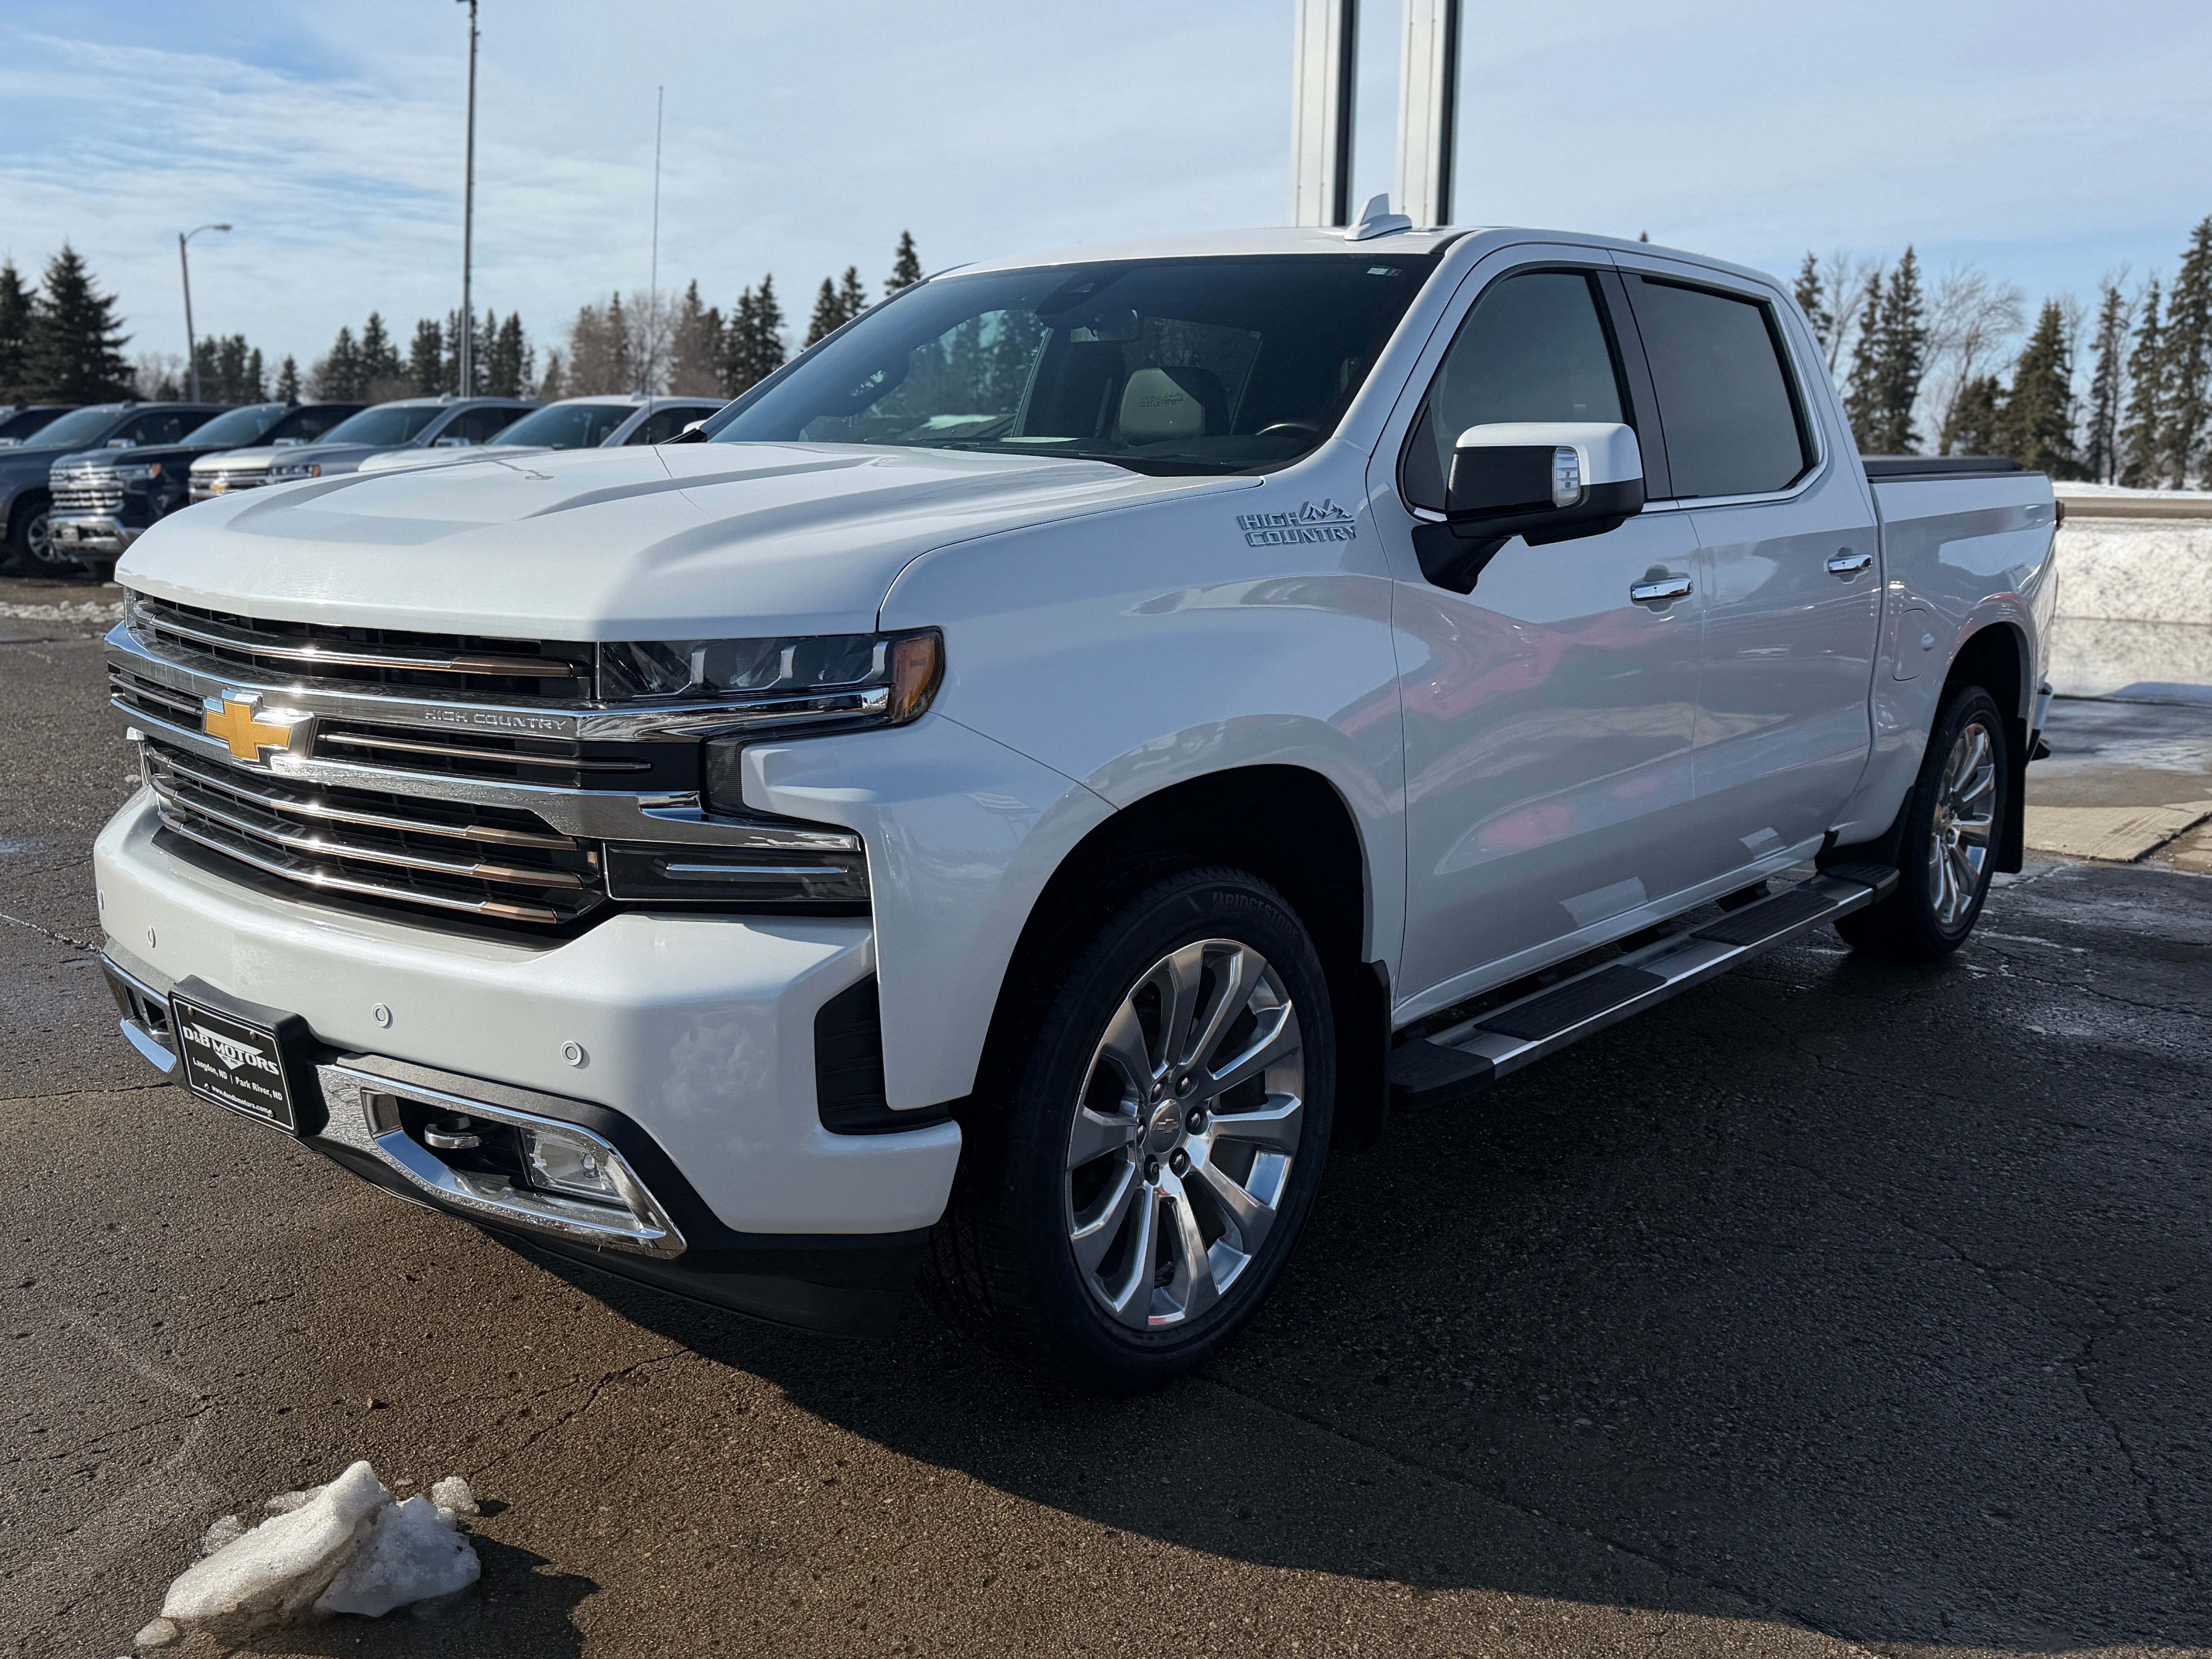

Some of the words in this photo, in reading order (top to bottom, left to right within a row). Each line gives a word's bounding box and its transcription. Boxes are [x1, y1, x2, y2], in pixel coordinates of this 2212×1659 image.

[1237, 512, 1298, 530] HIGH
[1246, 526, 1356, 547] COUNTRY
[425, 709, 468, 722] HIGH
[474, 714, 566, 730] COUNTRY
[182, 1026, 210, 1048] D&B
[212, 1039, 279, 1075] MOTORS
[218, 1068, 227, 1080] ND
[235, 1076, 251, 1089] Park
[251, 1082, 272, 1098] River,
[272, 1090, 282, 1101] ND
